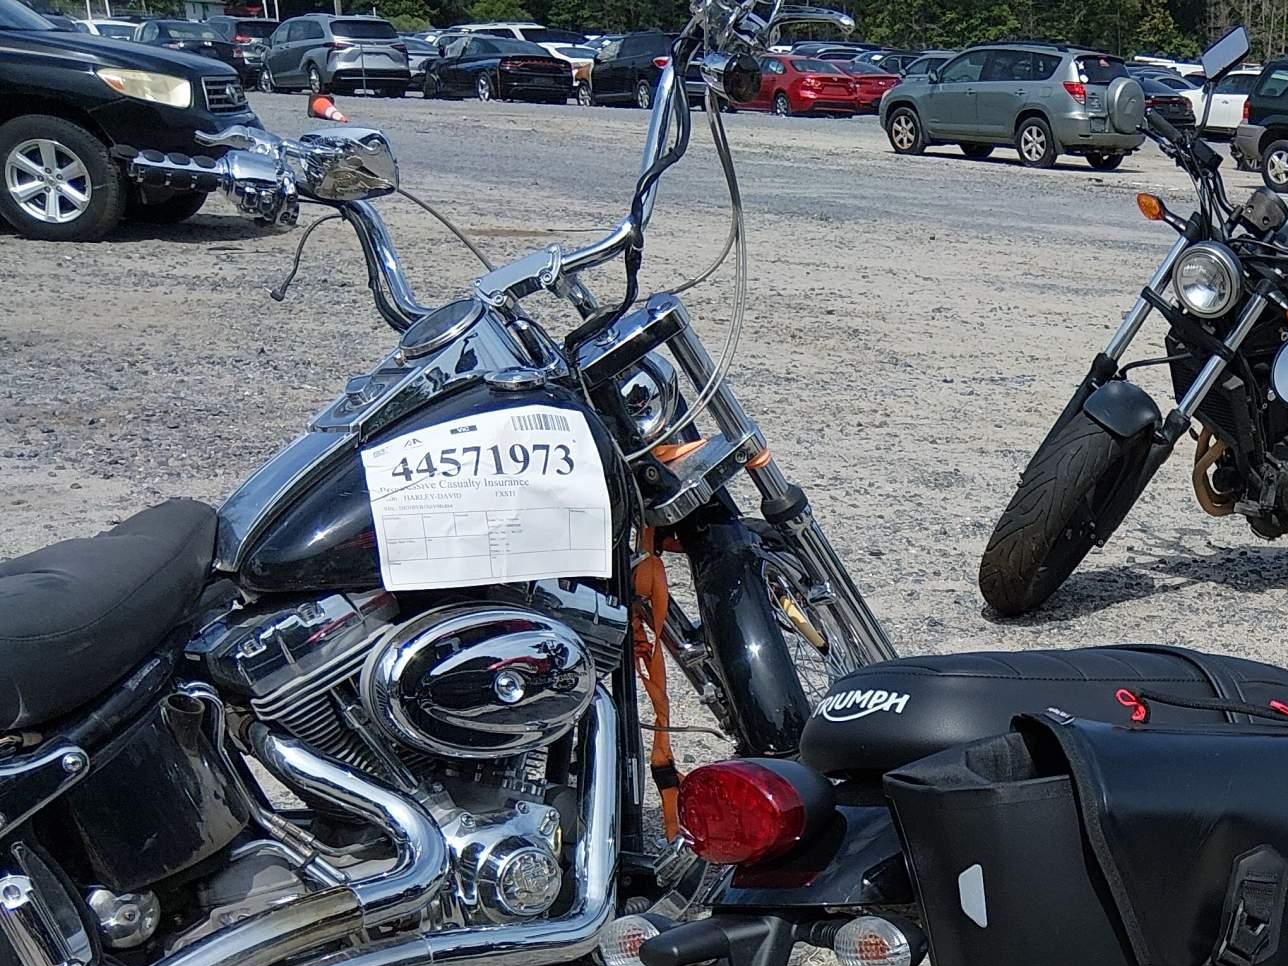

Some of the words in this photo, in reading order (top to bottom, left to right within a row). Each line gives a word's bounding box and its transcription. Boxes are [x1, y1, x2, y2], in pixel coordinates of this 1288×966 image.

[391, 443, 575, 481] 44571973
[439, 478, 481, 489] Casualty
[484, 477, 529, 487] Insurance
[812, 690, 910, 722] TRIUMPH
